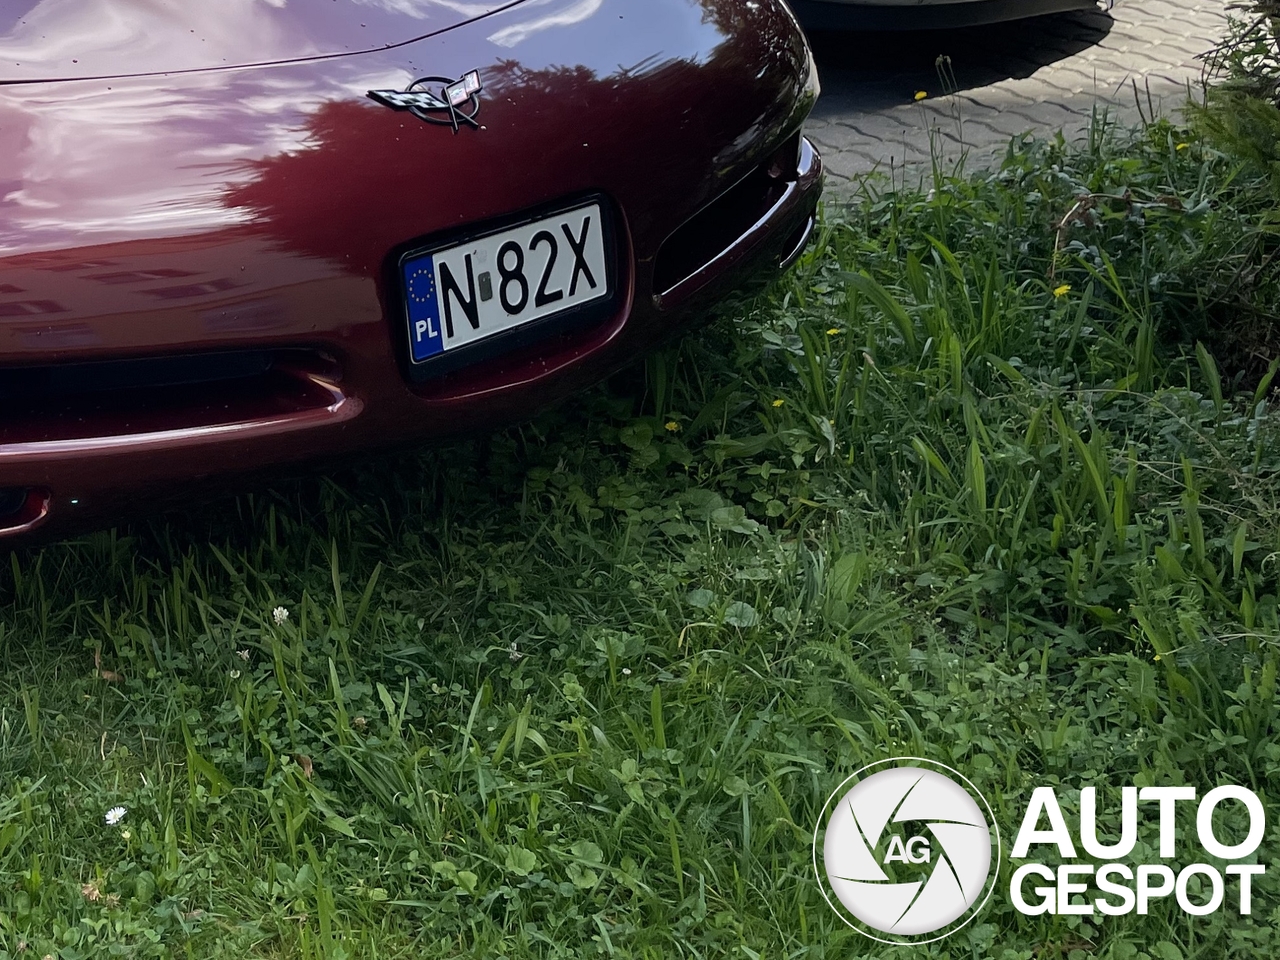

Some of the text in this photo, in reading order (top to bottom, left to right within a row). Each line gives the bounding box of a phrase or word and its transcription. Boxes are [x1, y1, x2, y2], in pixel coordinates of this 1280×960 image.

[415, 215, 597, 342] PL N 82X
